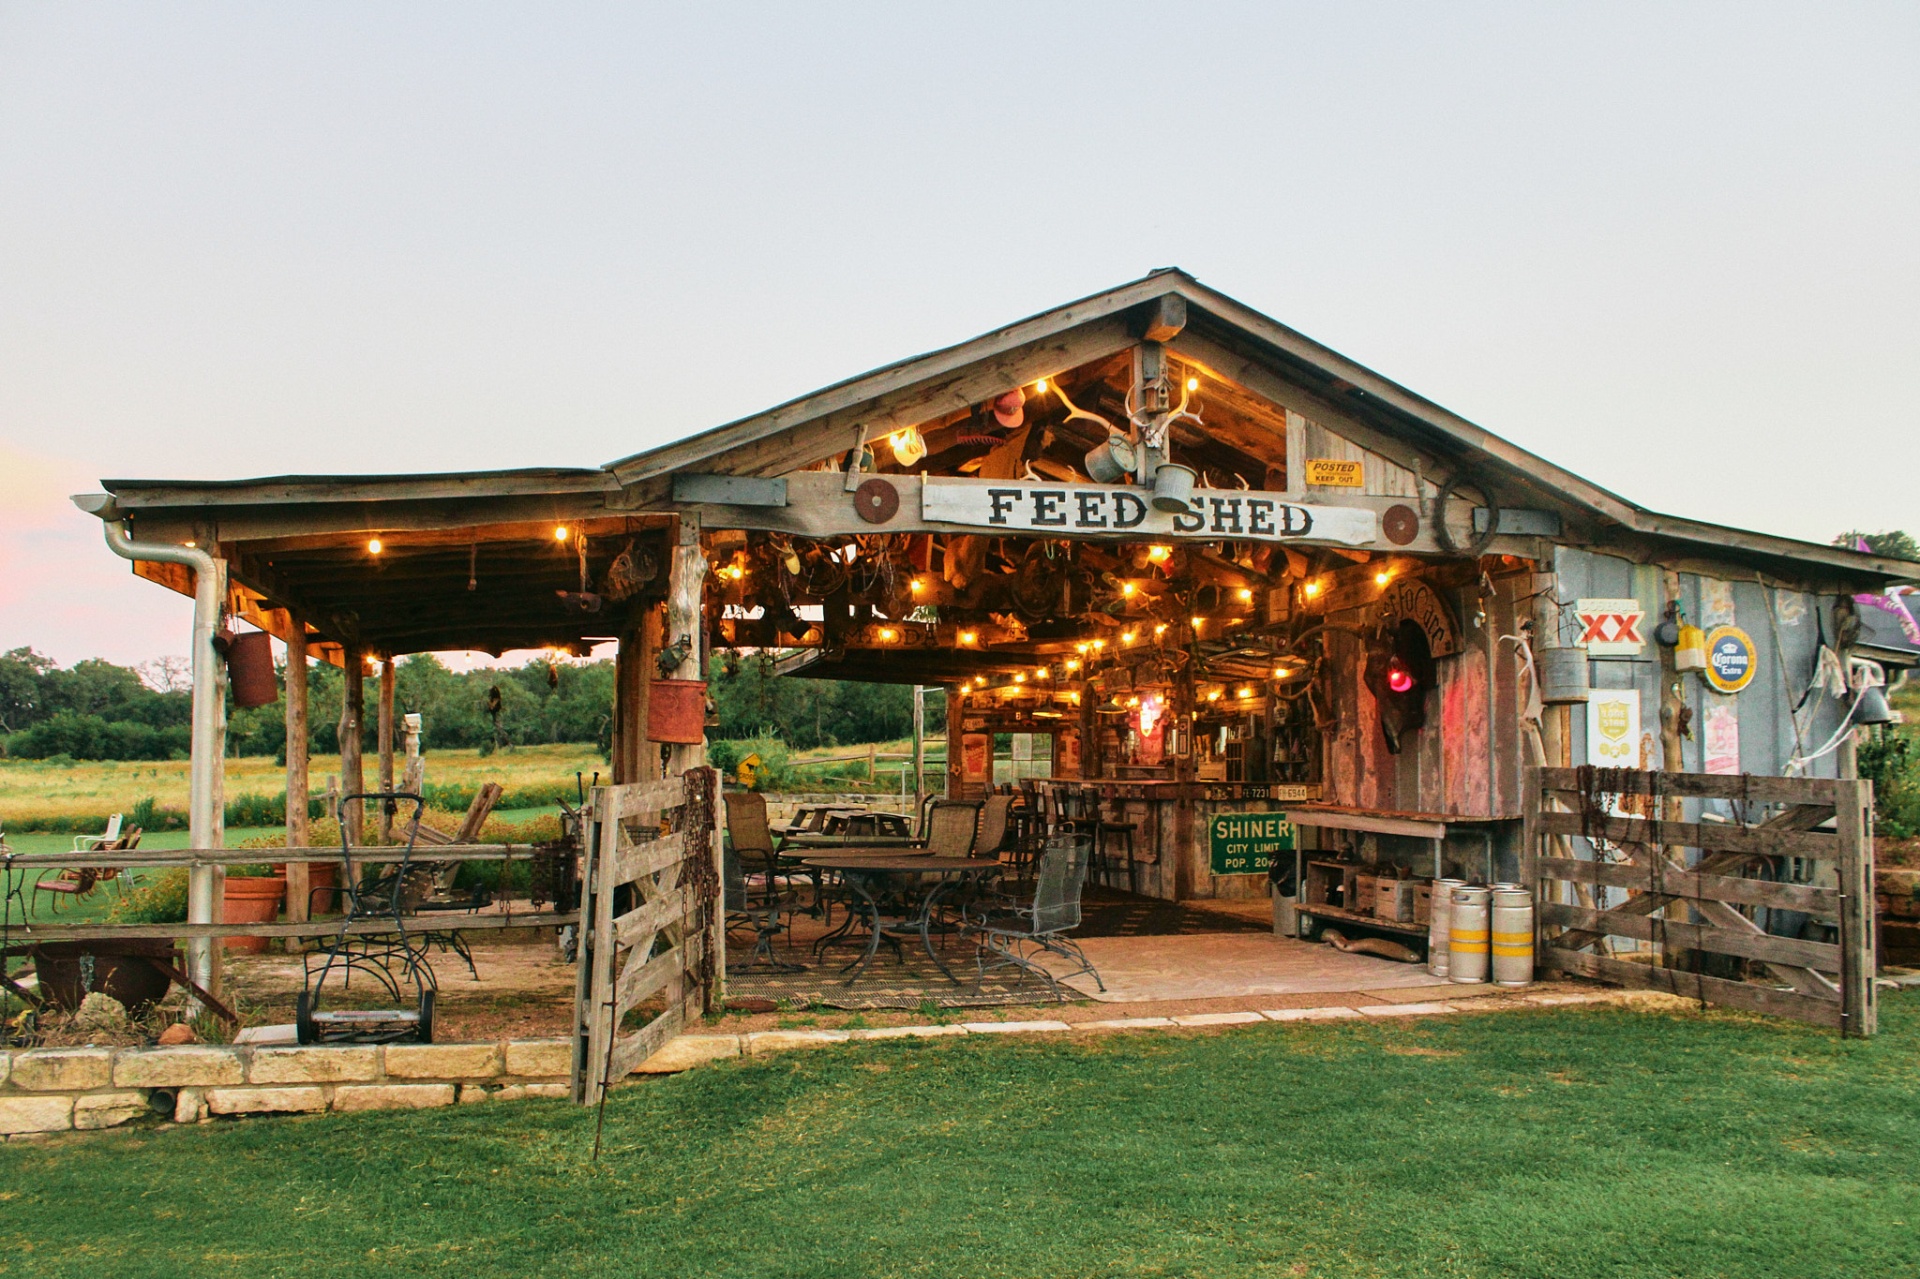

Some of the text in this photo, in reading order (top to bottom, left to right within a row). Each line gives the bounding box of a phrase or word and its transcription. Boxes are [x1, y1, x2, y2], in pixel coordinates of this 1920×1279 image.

[1313, 462, 1355, 472] POSTED
[987, 488, 1315, 537] FEED SHED
[1579, 614, 1640, 642] XX
[1711, 652, 1748, 667] Corona
[1722, 665, 1742, 675] Extra
[1603, 719, 1625, 727] STAR
[1216, 820, 1290, 839] SHINER
[1226, 842, 1280, 854] CITY LIMIT
[1225, 858, 1249, 868] POP.
